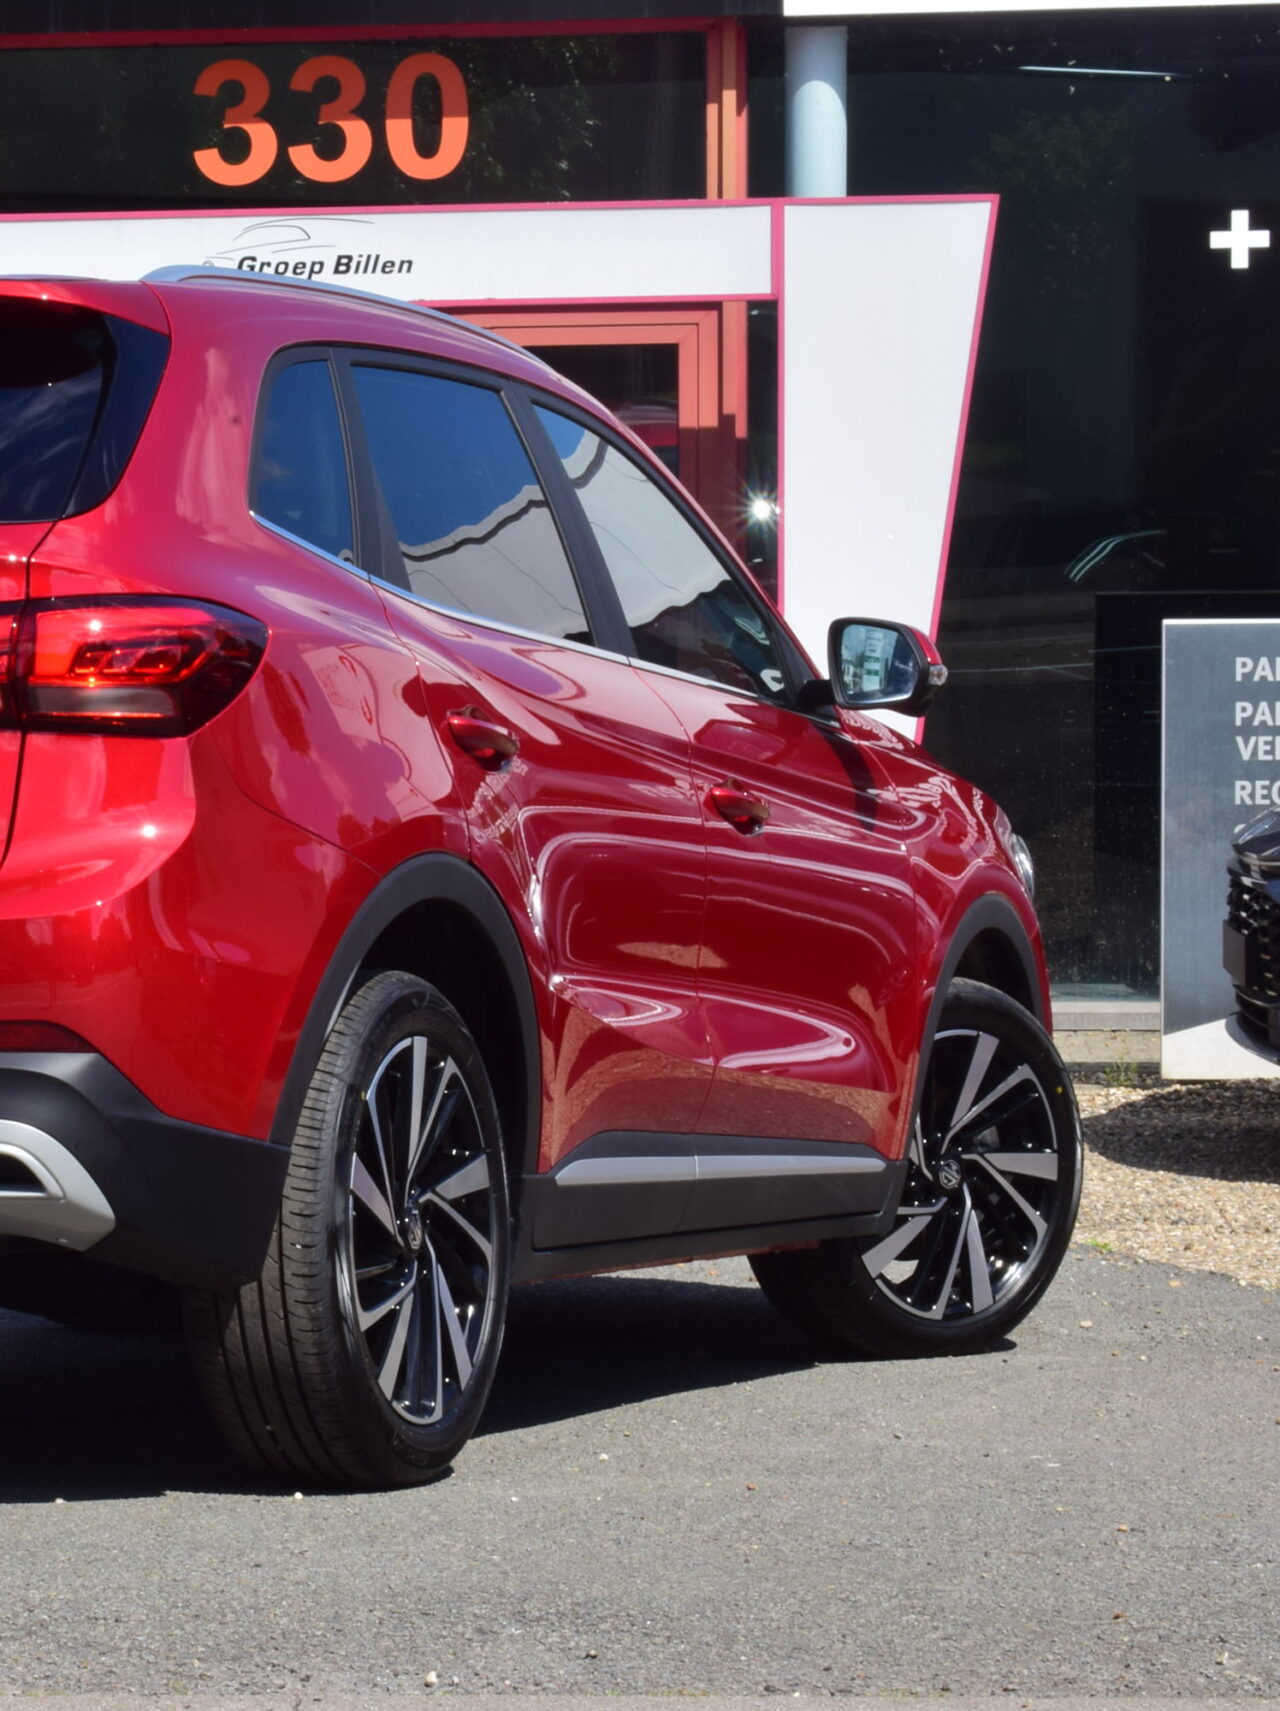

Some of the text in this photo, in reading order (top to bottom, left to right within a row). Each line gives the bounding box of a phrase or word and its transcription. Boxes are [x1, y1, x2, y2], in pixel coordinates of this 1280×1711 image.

[193, 52, 470, 187] 330
[236, 254, 414, 280] Groep Billen
